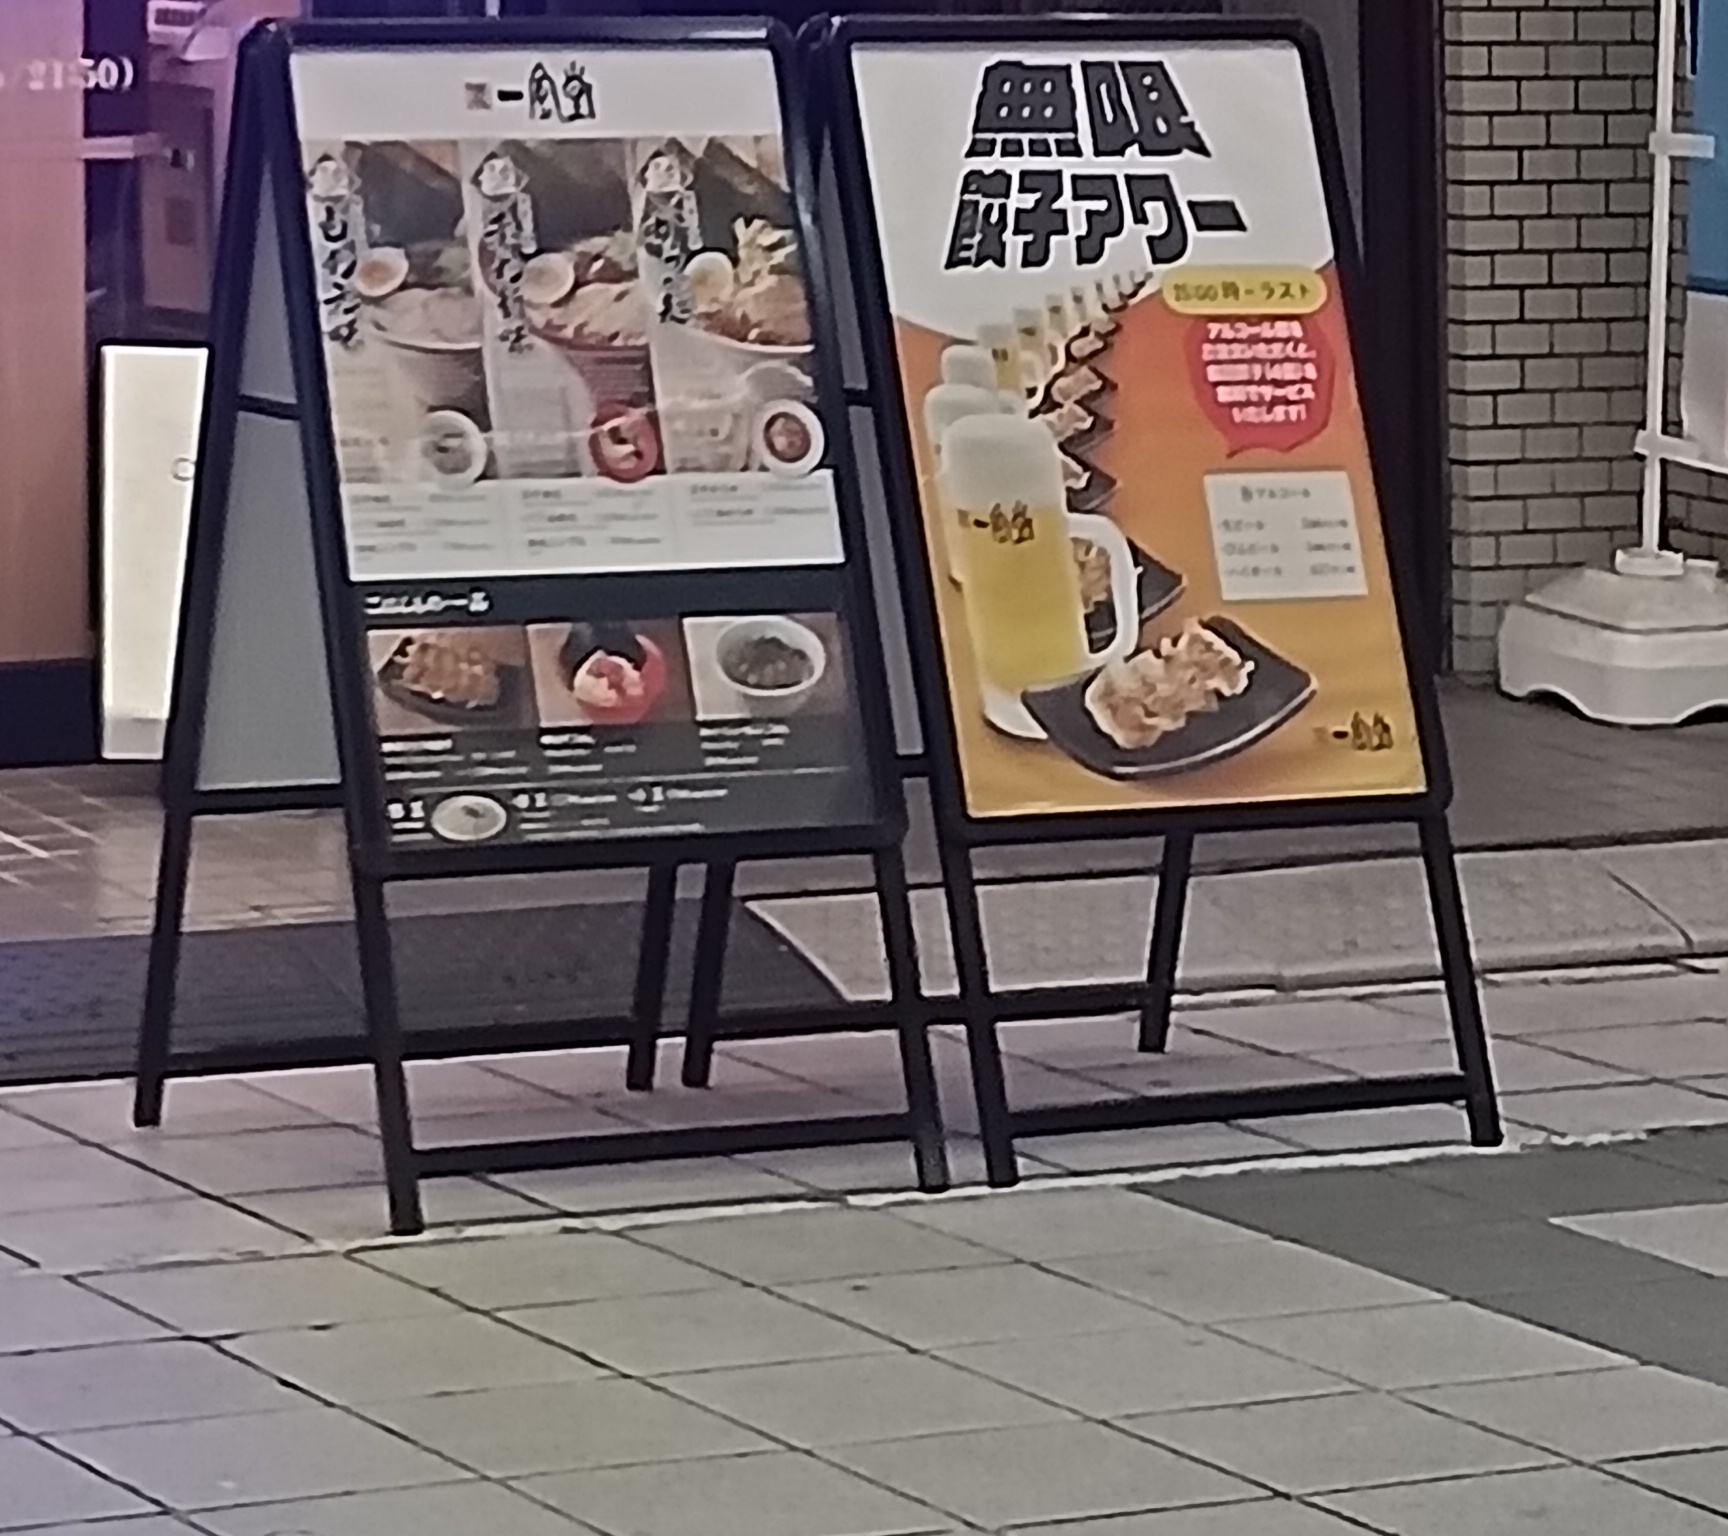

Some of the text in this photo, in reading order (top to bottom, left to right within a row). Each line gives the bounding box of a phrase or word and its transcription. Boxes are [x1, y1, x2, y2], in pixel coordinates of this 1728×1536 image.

[964, 60, 1212, 158] 無限
[944, 169, 1248, 270] 餃子アワー
